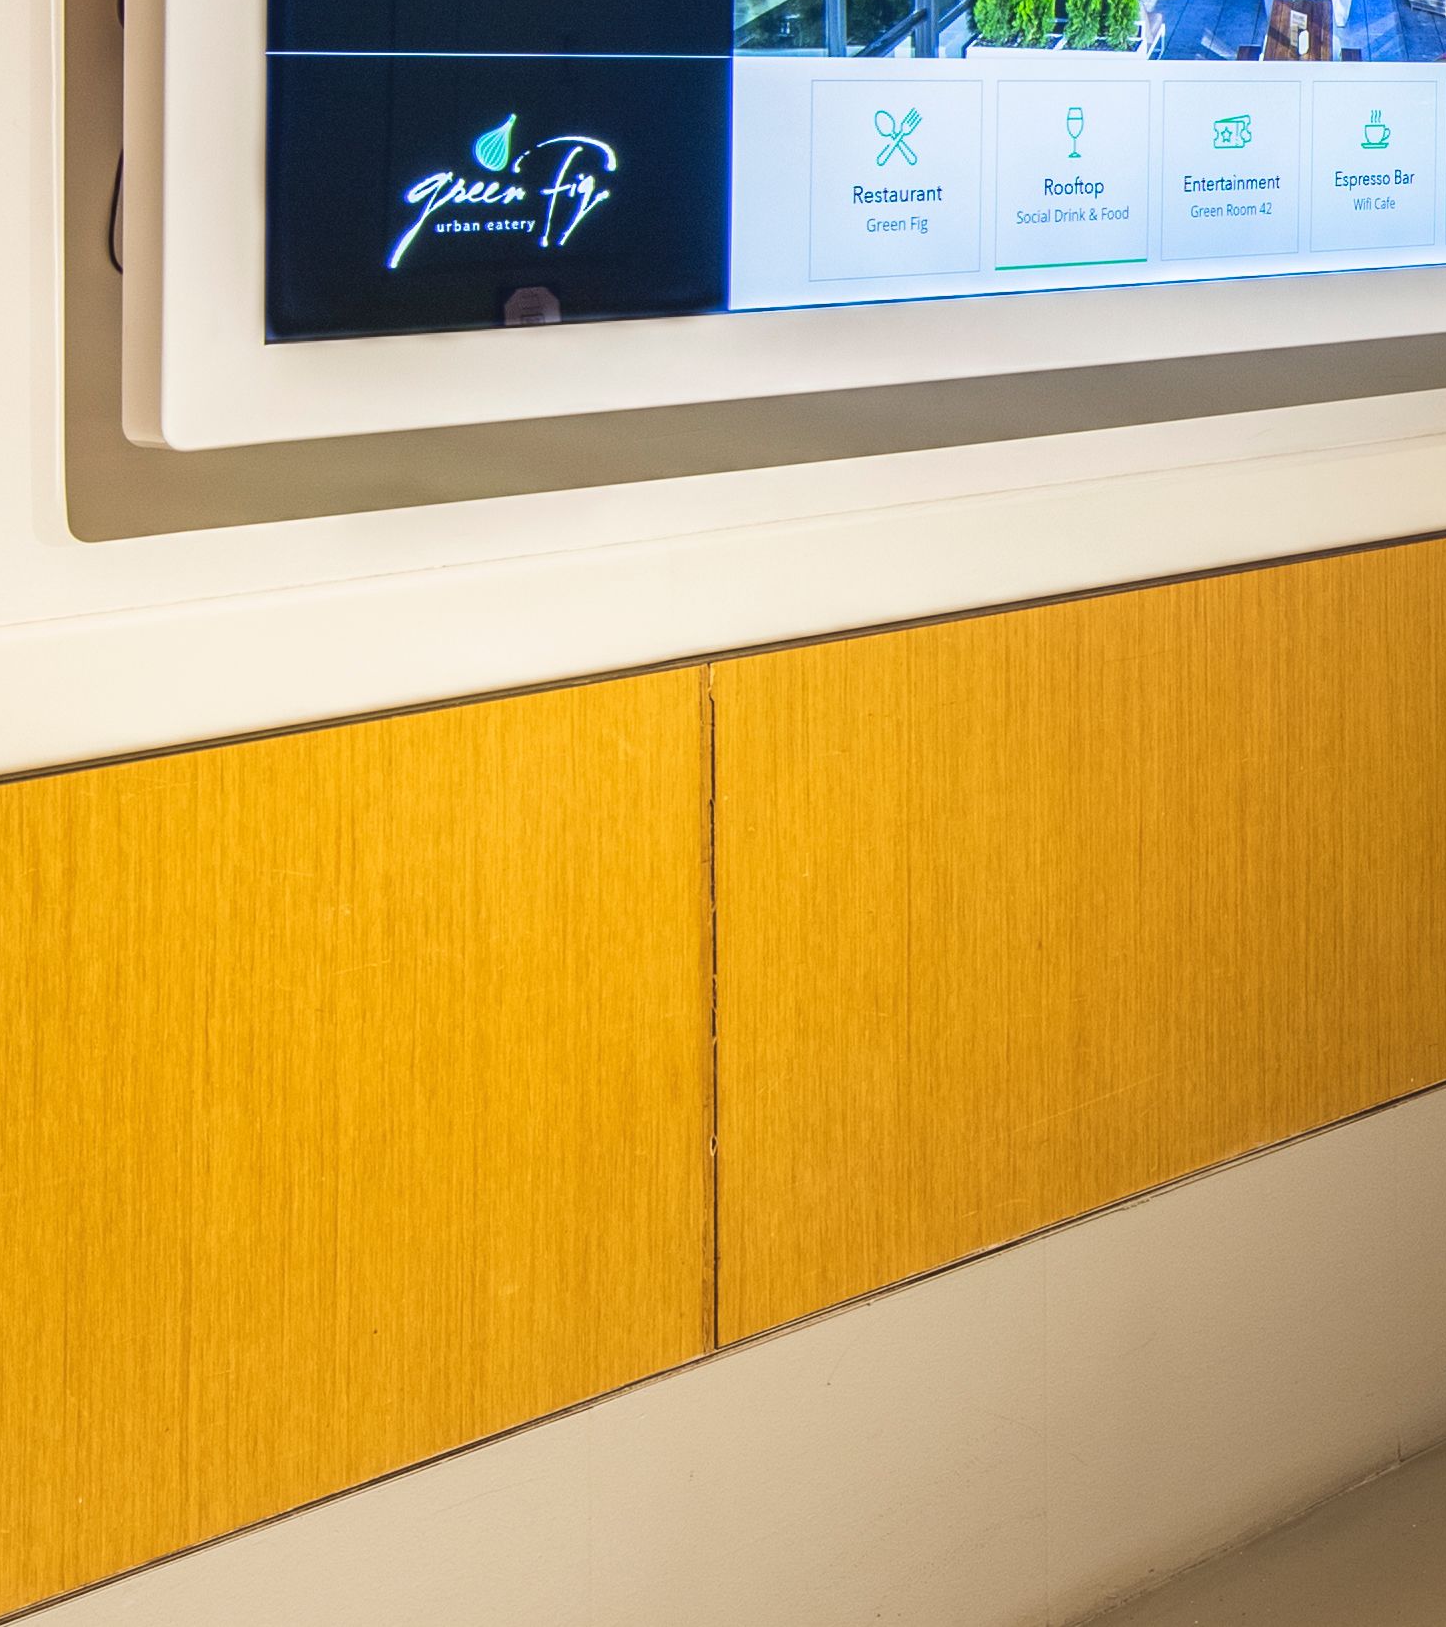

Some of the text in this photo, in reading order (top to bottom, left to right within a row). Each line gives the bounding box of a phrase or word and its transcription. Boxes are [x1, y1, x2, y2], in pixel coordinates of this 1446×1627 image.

[1044, 177, 1105, 199] Rooftop
[1184, 175, 1280, 193] Entertainment
[1335, 170, 1415, 190] Espresso Bar
[853, 184, 943, 204] Restaurant
[1191, 201, 1272, 219] Green Room 42
[1354, 196, 1396, 212] Wifi Cafe
[387, 169, 526, 269] green
[436, 217, 536, 233] urban eatery
[1017, 206, 1130, 225] Social Drink & Food
[866, 216, 928, 235] Green Fig
